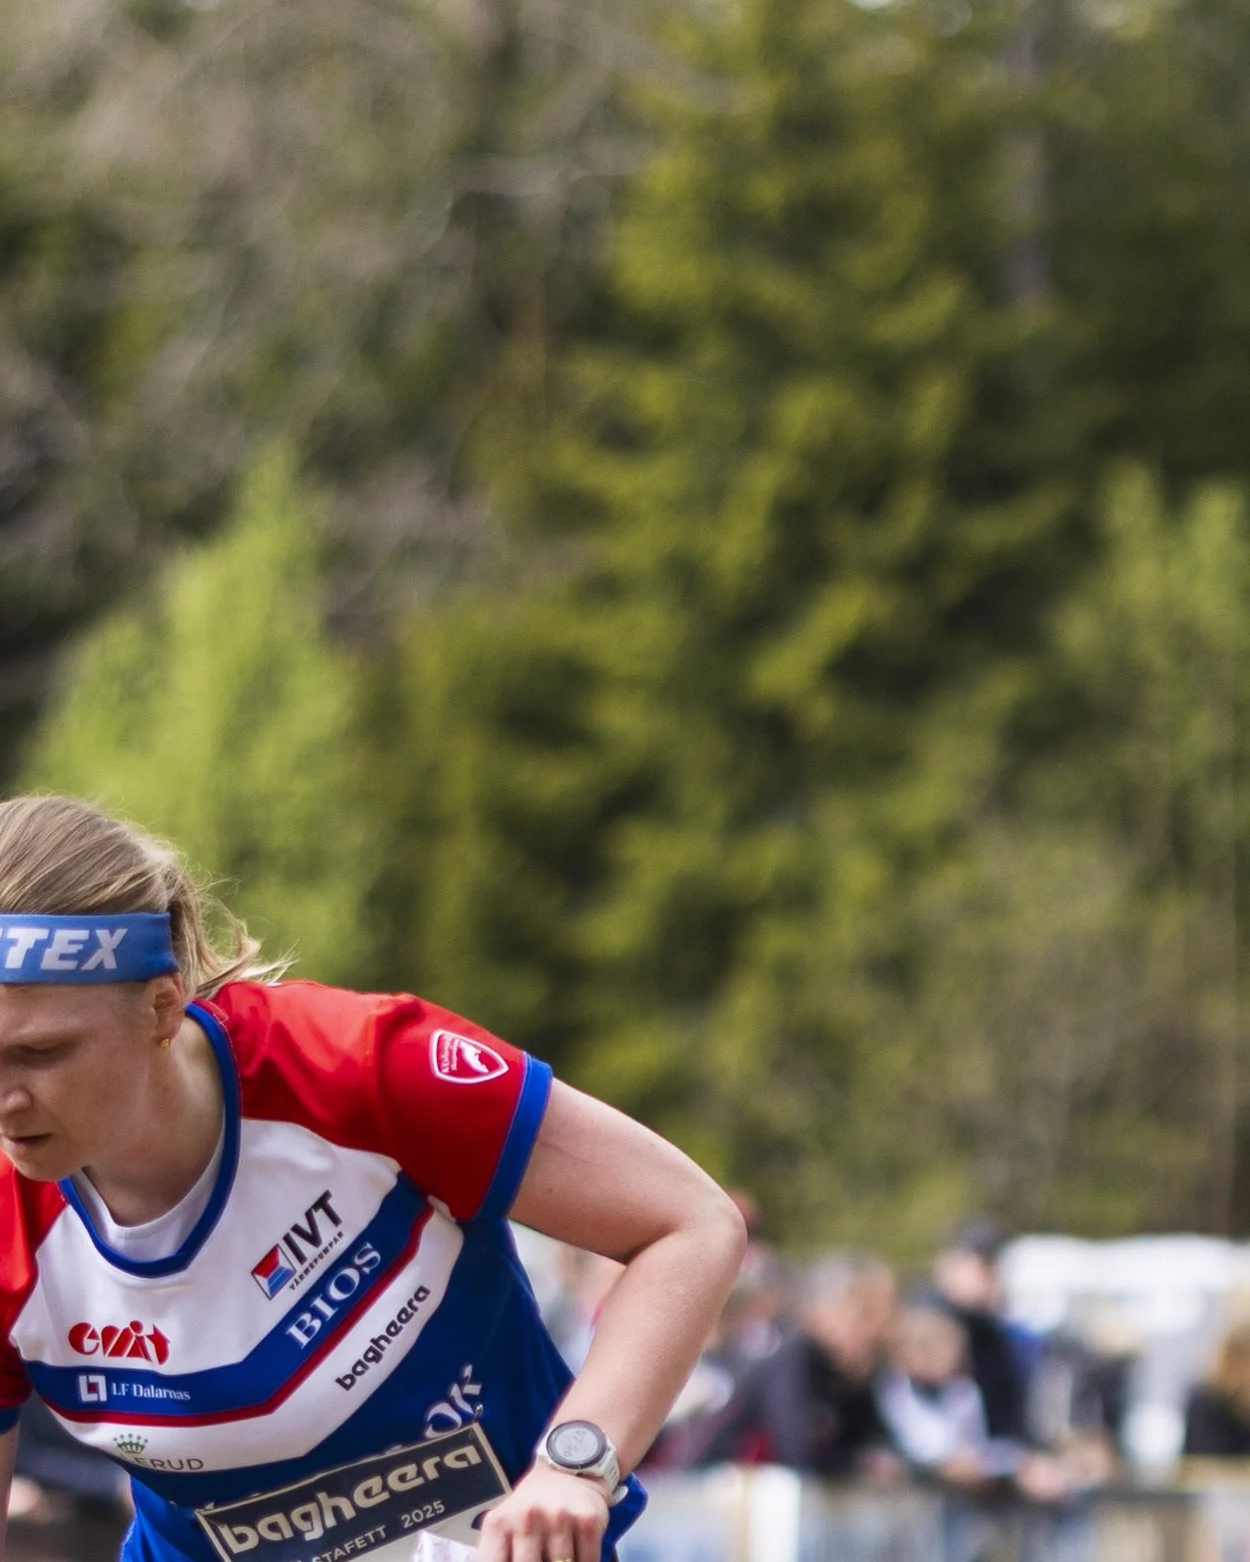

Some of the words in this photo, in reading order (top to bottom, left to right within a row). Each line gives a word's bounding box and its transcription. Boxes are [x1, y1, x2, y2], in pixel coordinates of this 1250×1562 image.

[282, 1188, 343, 1266] IVT
[285, 1241, 382, 1349] BIOS
[335, 1285, 431, 1391] bagheera
[112, 1382, 130, 1396] LF
[133, 1384, 191, 1401] Dalarnas
[222, 1444, 482, 1555] bagheera
[401, 1500, 446, 1529] 2025
